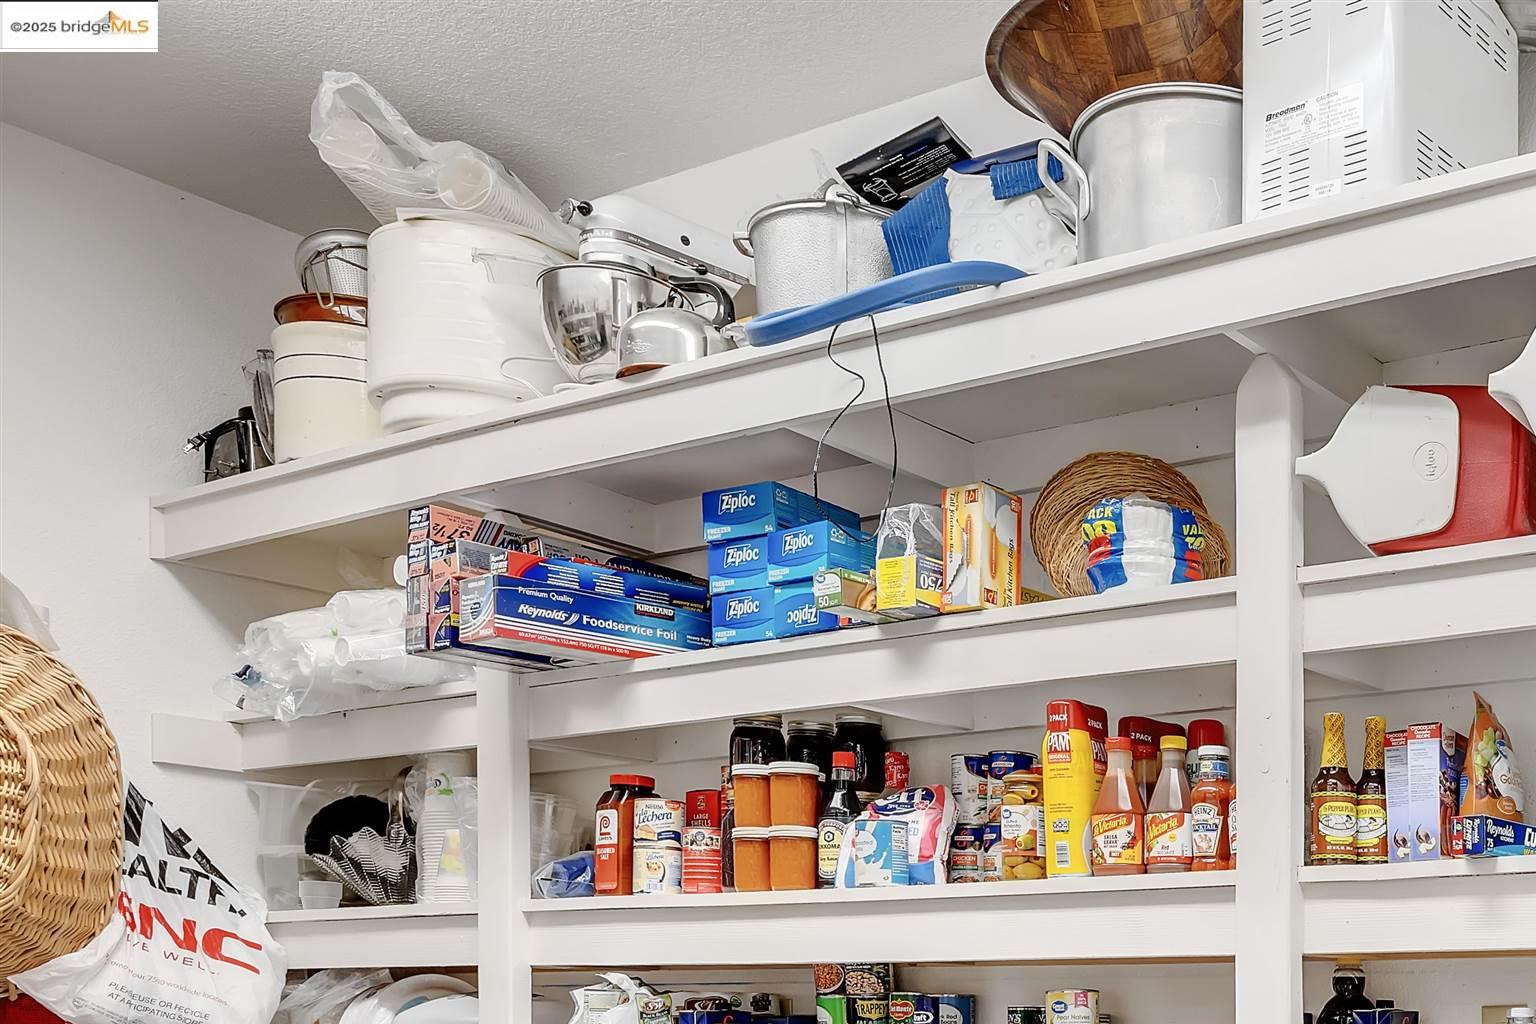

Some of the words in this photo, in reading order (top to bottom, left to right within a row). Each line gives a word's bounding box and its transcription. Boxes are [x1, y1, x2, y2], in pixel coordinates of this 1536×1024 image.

[1265, 103, 1306, 121] Breadman
[722, 494, 757, 512] Ziploc
[784, 533, 814, 552] Ziploc
[727, 547, 760, 566] Ziploc
[518, 586, 548, 600] Premium
[550, 591, 574, 605] Quality
[818, 596, 829, 607] 50
[635, 603, 674, 617] KIRKLAND
[729, 600, 760, 619] Ziploc
[787, 607, 817, 623] Ziploc
[518, 604, 569, 621] Reynolds
[582, 616, 653, 637] Foodservice
[656, 628, 677, 641] Foil
[1091, 720, 1103, 729] PACK
[1048, 732, 1071, 752] PAM
[1136, 734, 1152, 742] PACK
[1194, 807, 1212, 816] HEINZ
[1099, 817, 1127, 832] Victoria
[1148, 817, 1178, 838] Victoria
[1486, 819, 1514, 837] Reynolds
[1487, 838, 1494, 848] 75
[159, 1000, 173, 1009] OR
